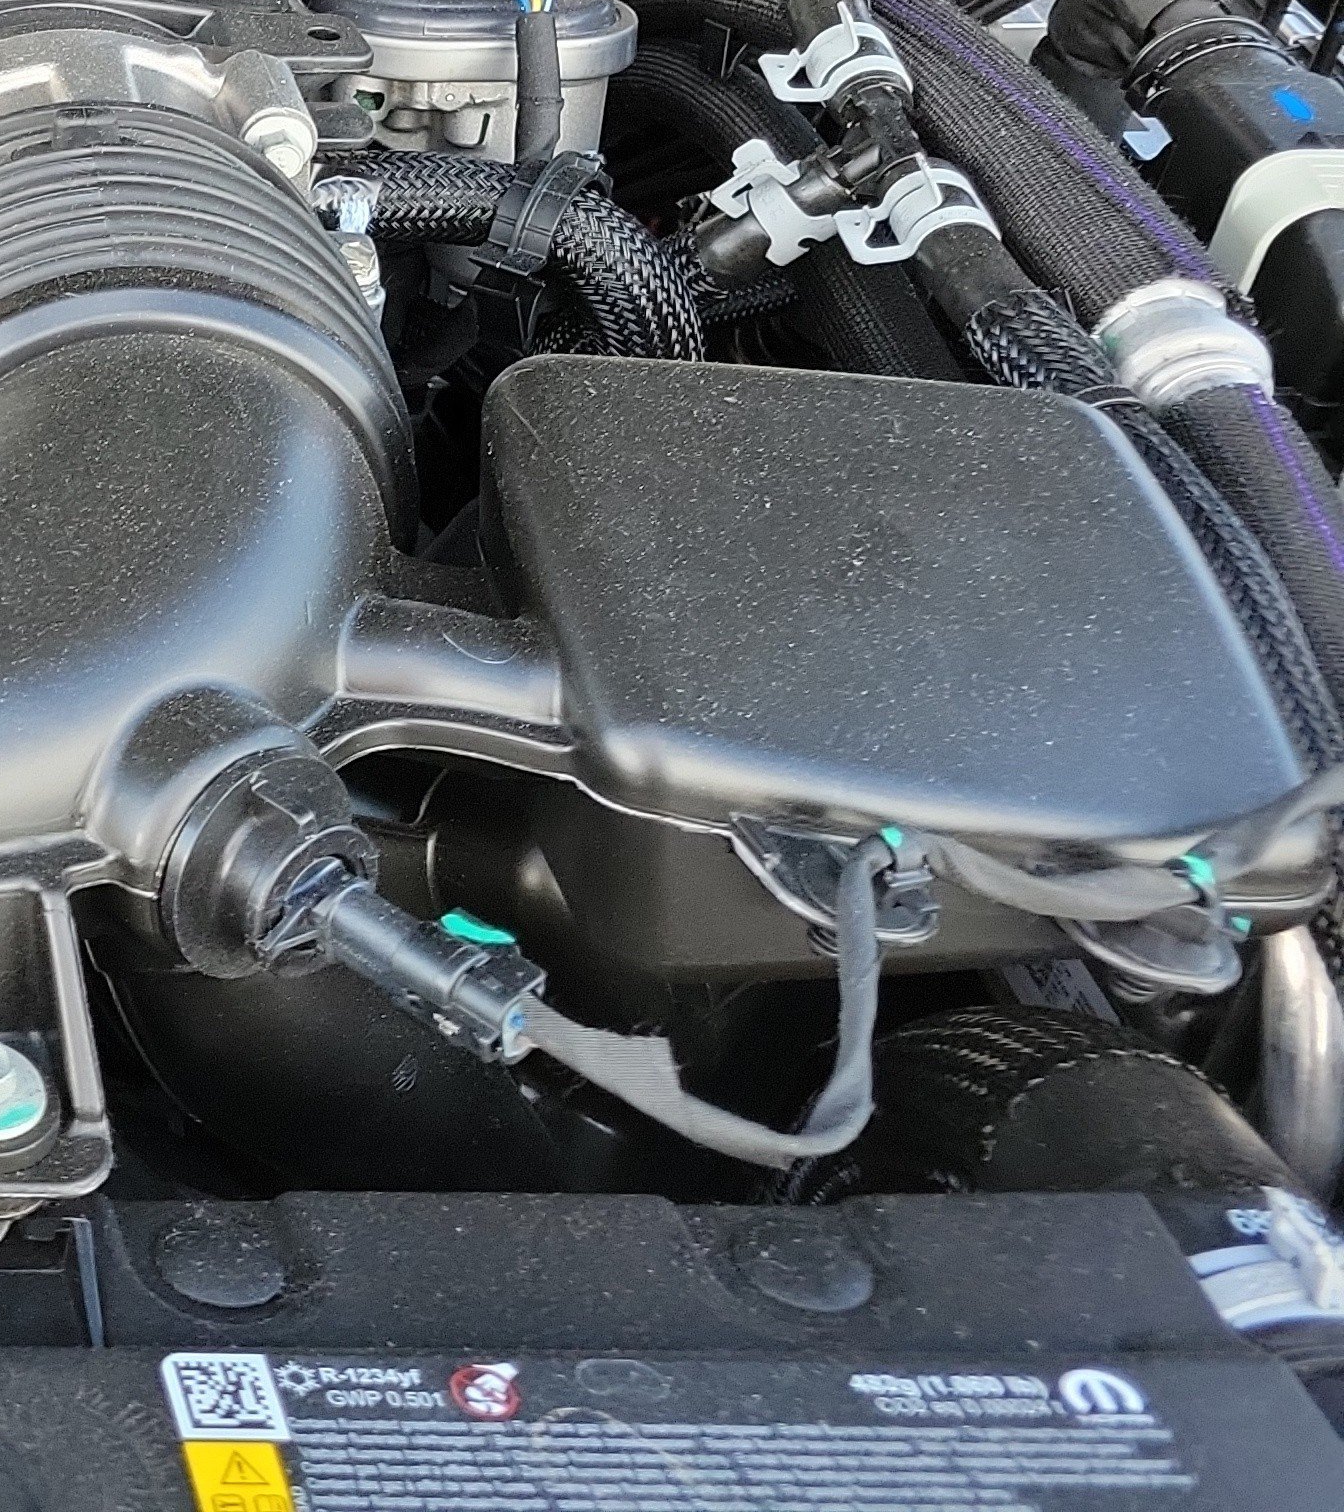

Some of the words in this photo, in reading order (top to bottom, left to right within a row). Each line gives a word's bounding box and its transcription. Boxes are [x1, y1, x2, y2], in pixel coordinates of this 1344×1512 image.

[318, 1367, 422, 1388] R-1234yf
[325, 1389, 383, 1407] GWP
[385, 1390, 446, 1407] 0.501
